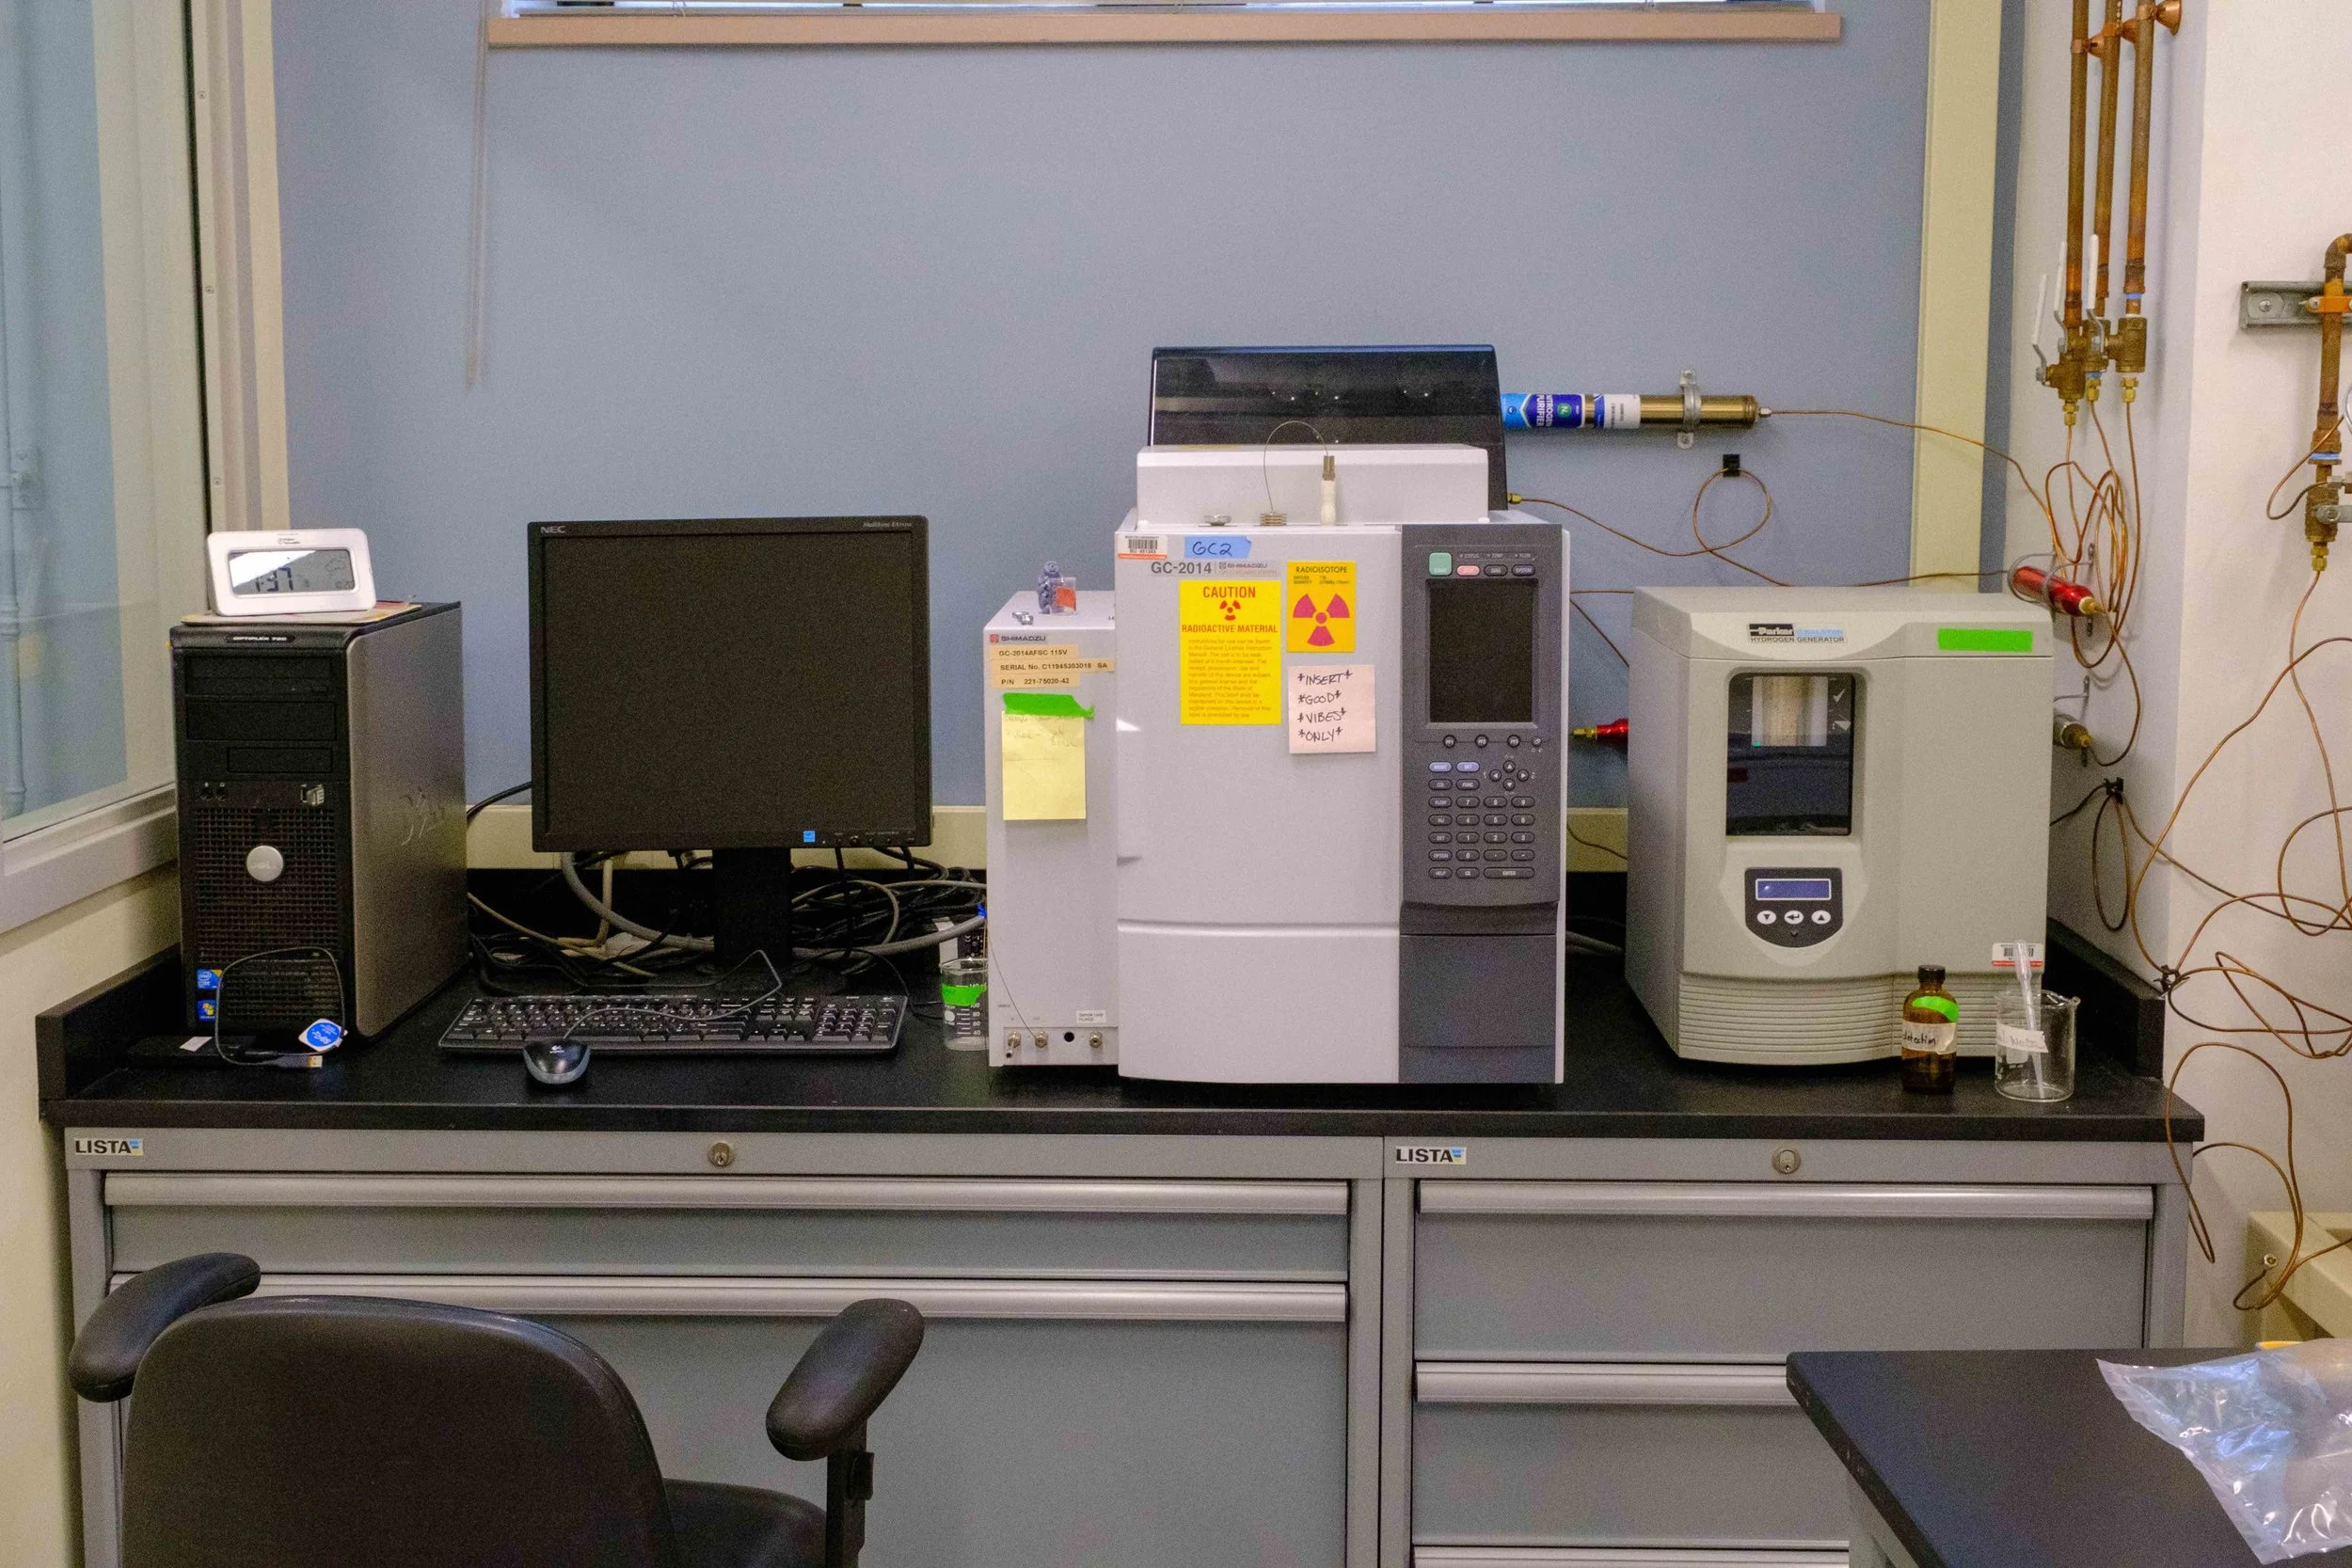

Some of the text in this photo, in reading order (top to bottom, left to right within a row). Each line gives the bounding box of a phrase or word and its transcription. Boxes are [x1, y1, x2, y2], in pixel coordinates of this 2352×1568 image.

[541, 526, 565, 534] NEC
[1192, 541, 1233, 557] GC2
[1151, 561, 1212, 574] GC-2014
[1202, 586, 1256, 598] CAUTION
[1182, 625, 1278, 633] RADIOACTIVE MATERIAL
[75, 1140, 132, 1153] LISTA
[1396, 1148, 1454, 1162] LISTA
